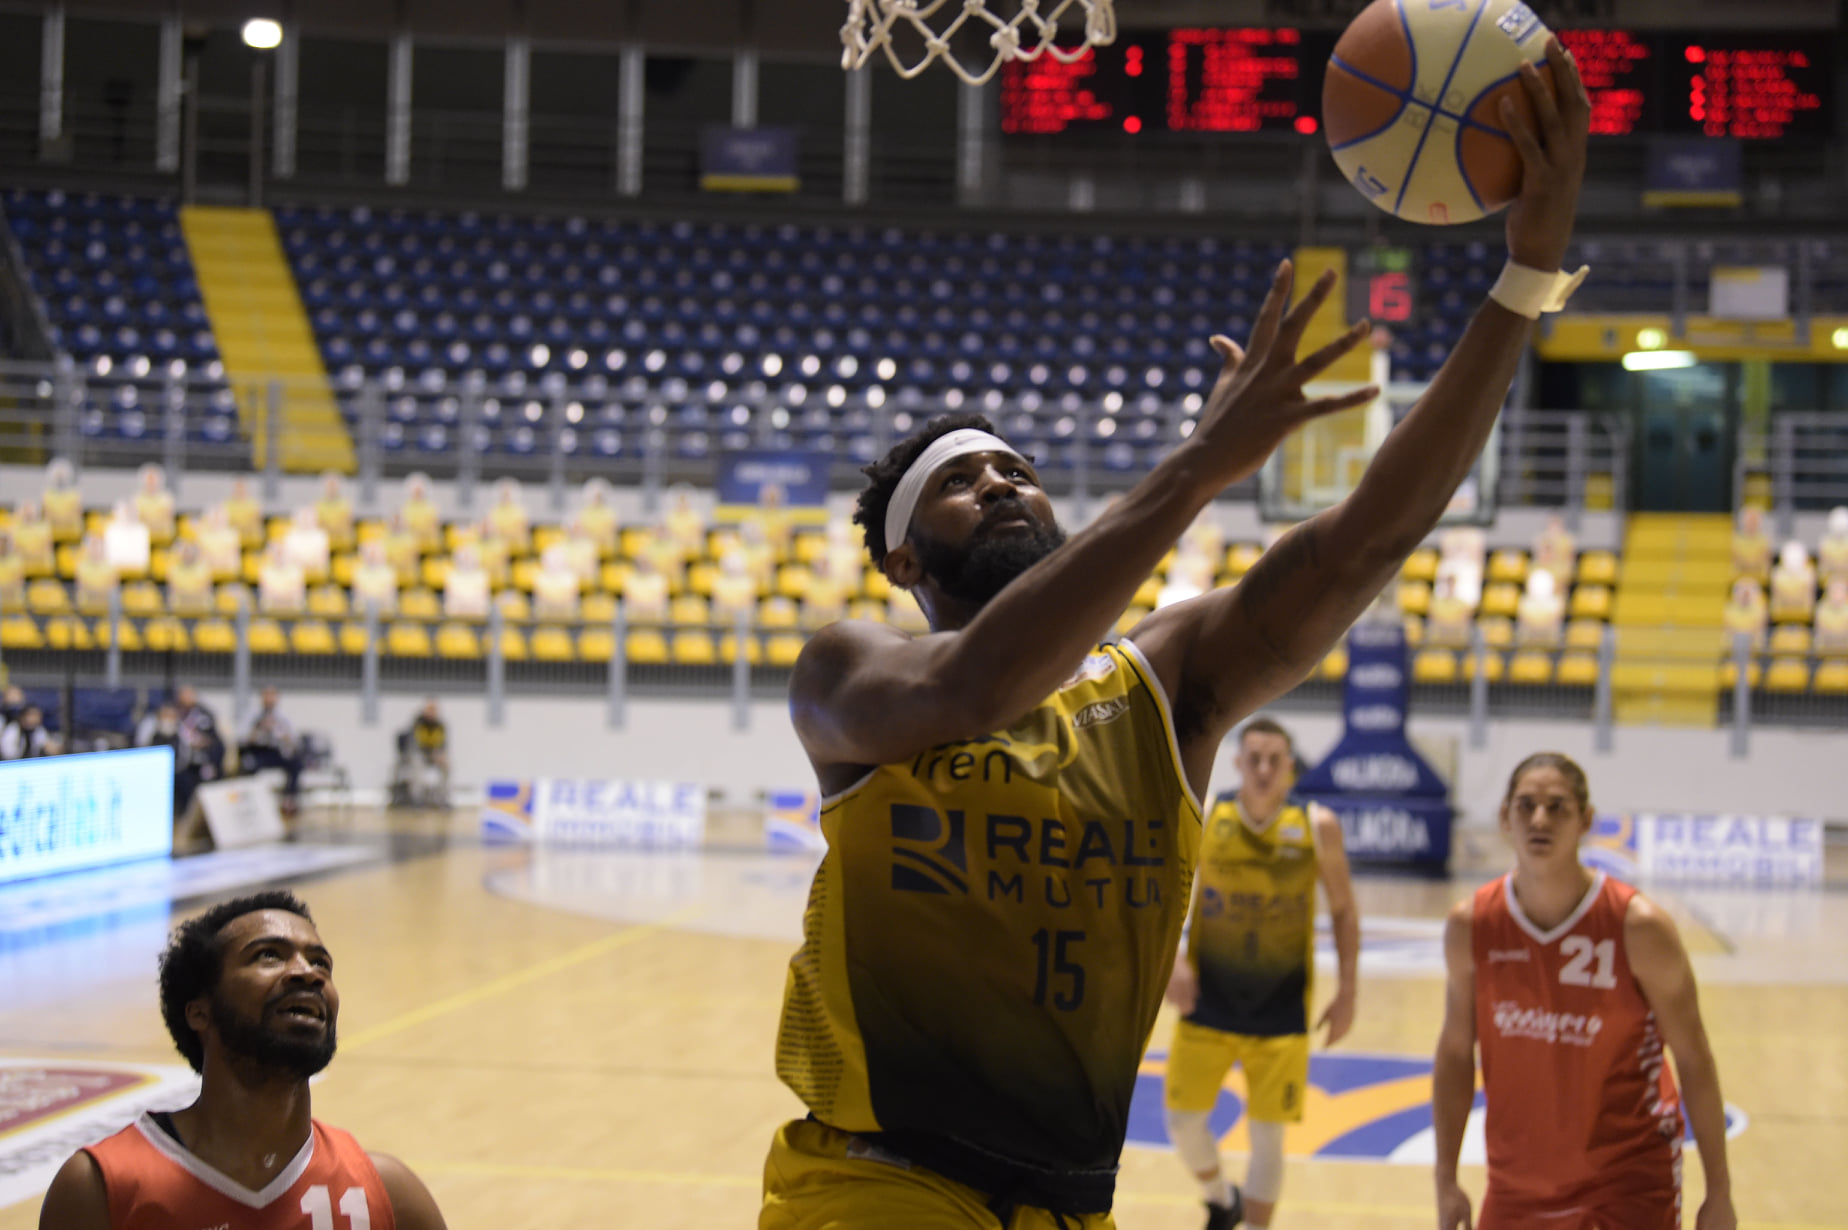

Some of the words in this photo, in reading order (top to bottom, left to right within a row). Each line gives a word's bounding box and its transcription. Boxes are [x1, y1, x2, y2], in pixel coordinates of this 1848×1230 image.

[986, 814, 1164, 869] REALE
[1655, 815, 1816, 850] REALE
[1031, 928, 1086, 1011] 15
[1559, 935, 1617, 989] 21
[300, 1184, 371, 1230] 11
